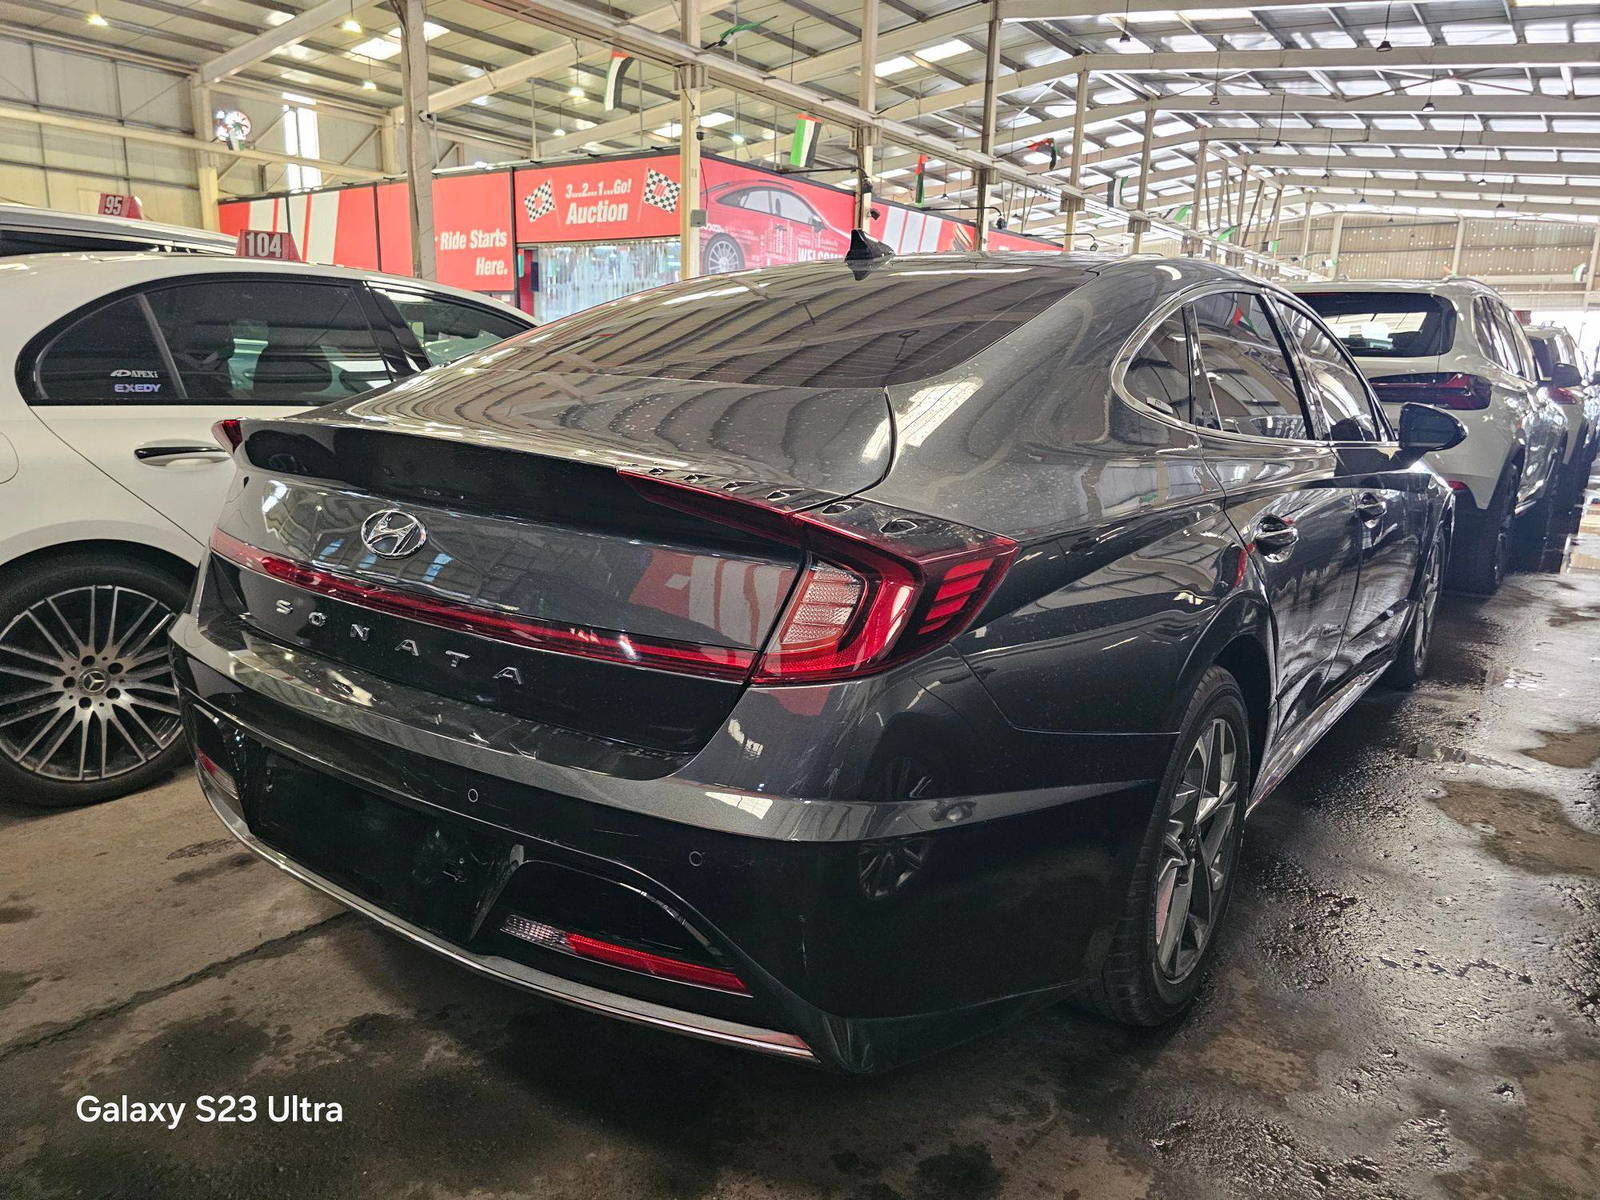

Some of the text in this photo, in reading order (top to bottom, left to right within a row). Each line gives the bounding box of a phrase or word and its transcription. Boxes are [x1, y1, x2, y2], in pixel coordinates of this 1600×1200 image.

[104, 196, 123, 215] 95
[565, 200, 629, 225] Auction
[246, 232, 282, 257] 104
[440, 228, 507, 250] Ride Starts
[475, 256, 508, 276] Here.
[114, 383, 161, 393] EXEDY
[275, 598, 522, 686] SONATA
